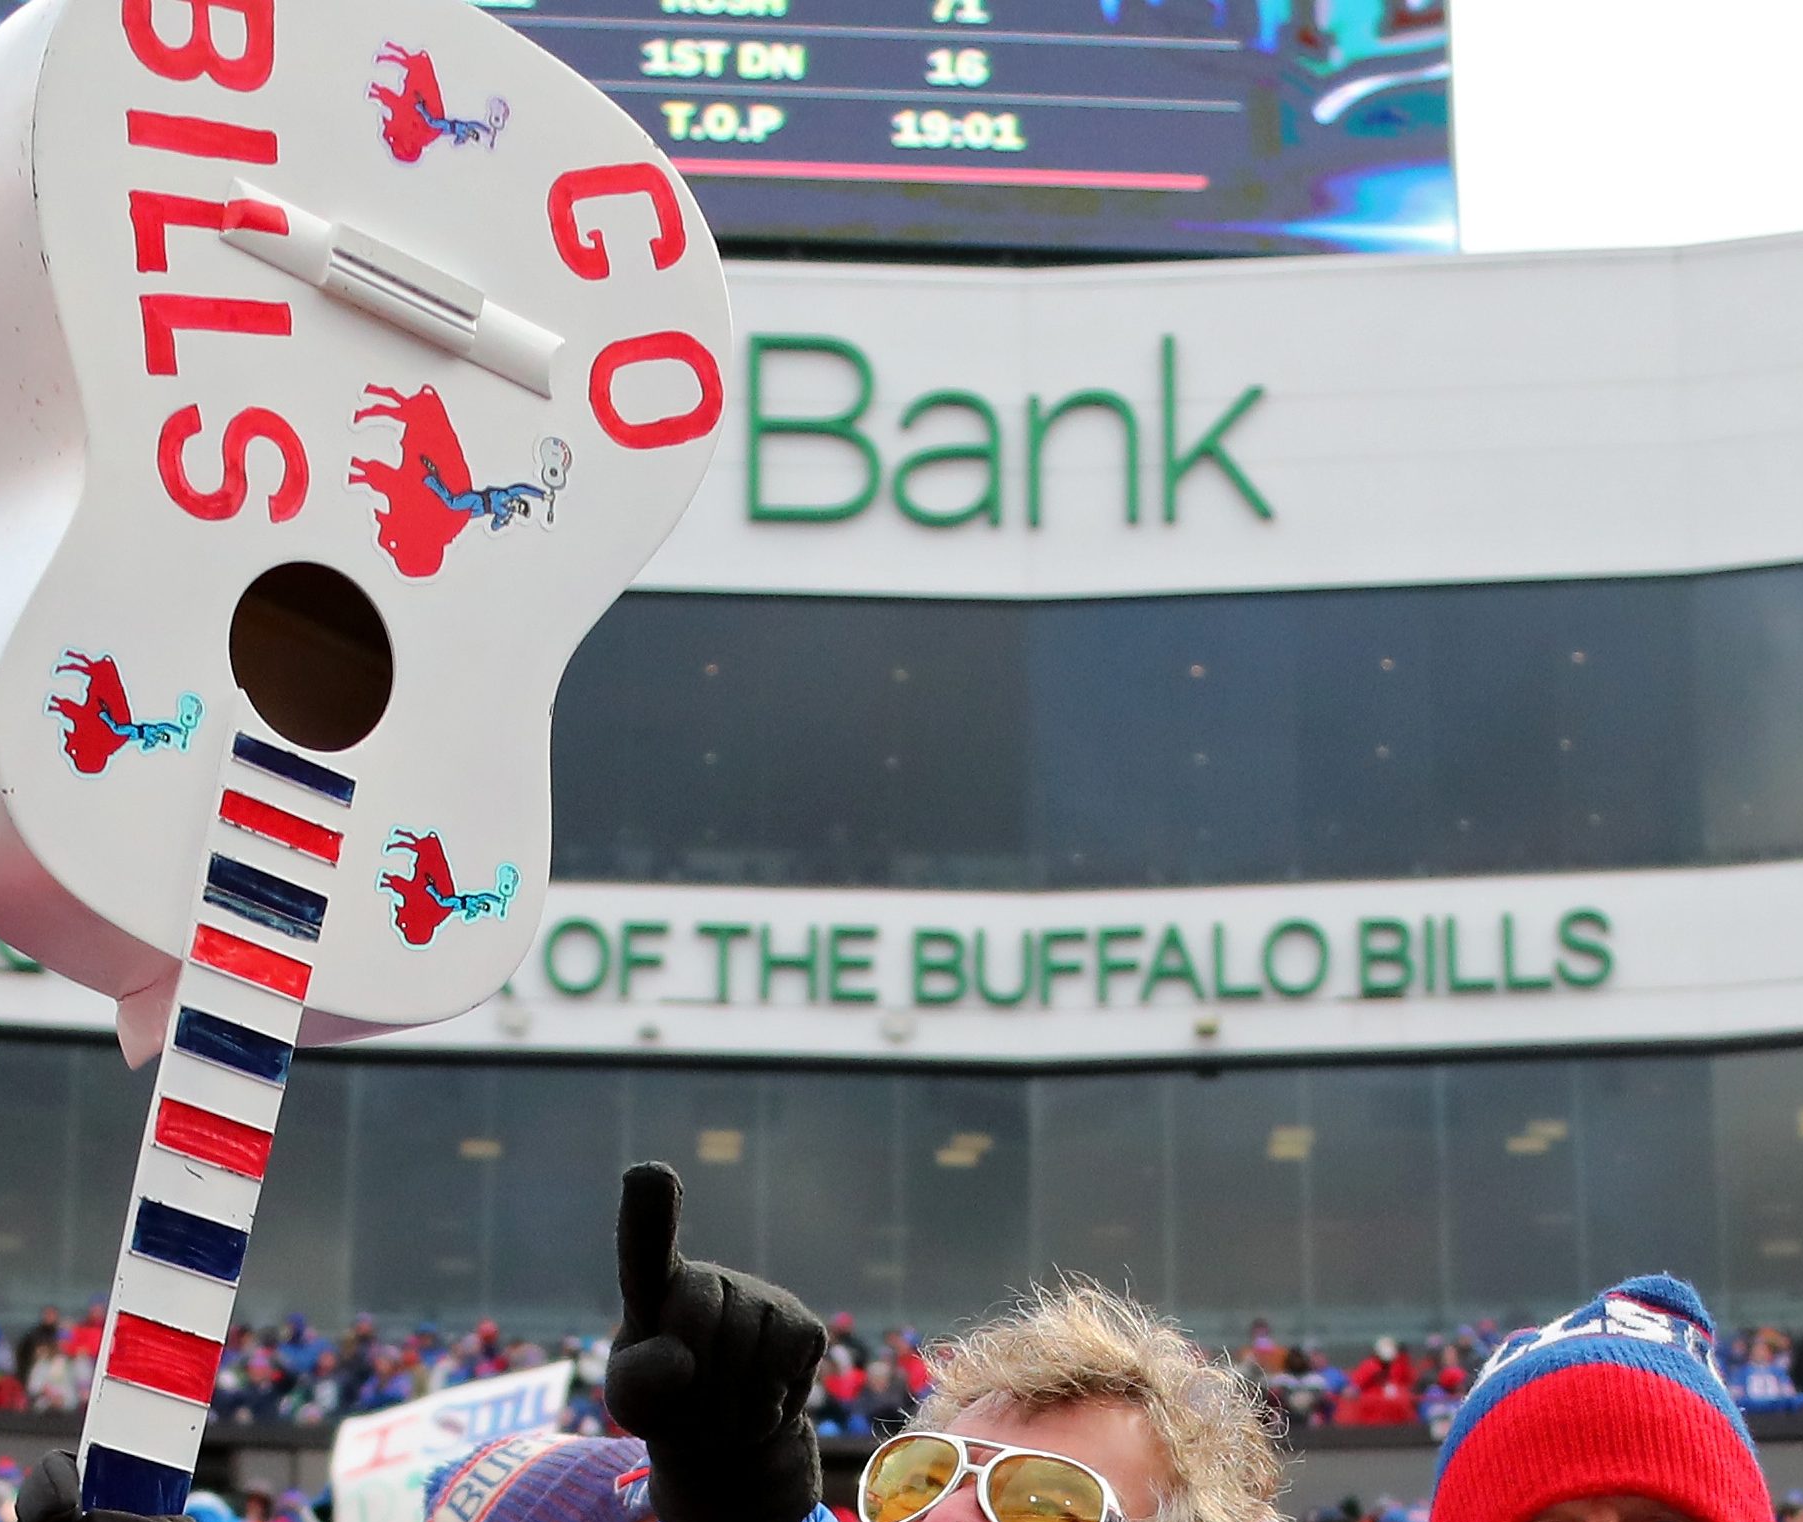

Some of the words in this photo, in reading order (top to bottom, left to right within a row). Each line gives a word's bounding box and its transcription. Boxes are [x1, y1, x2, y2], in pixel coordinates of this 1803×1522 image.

[639, 38, 733, 78] 1ST
[735, 41, 807, 81] DN
[924, 48, 991, 88] 16
[890, 110, 1027, 152] 19:01
[122, 0, 309, 523] BILLS
[547, 162, 723, 449] GO
[747, 332, 1274, 528] Bank
[544, 916, 667, 997] OF
[697, 923, 878, 1002] THE
[912, 918, 1330, 1006] BUFFALO
[1359, 907, 1615, 998] BILLS
